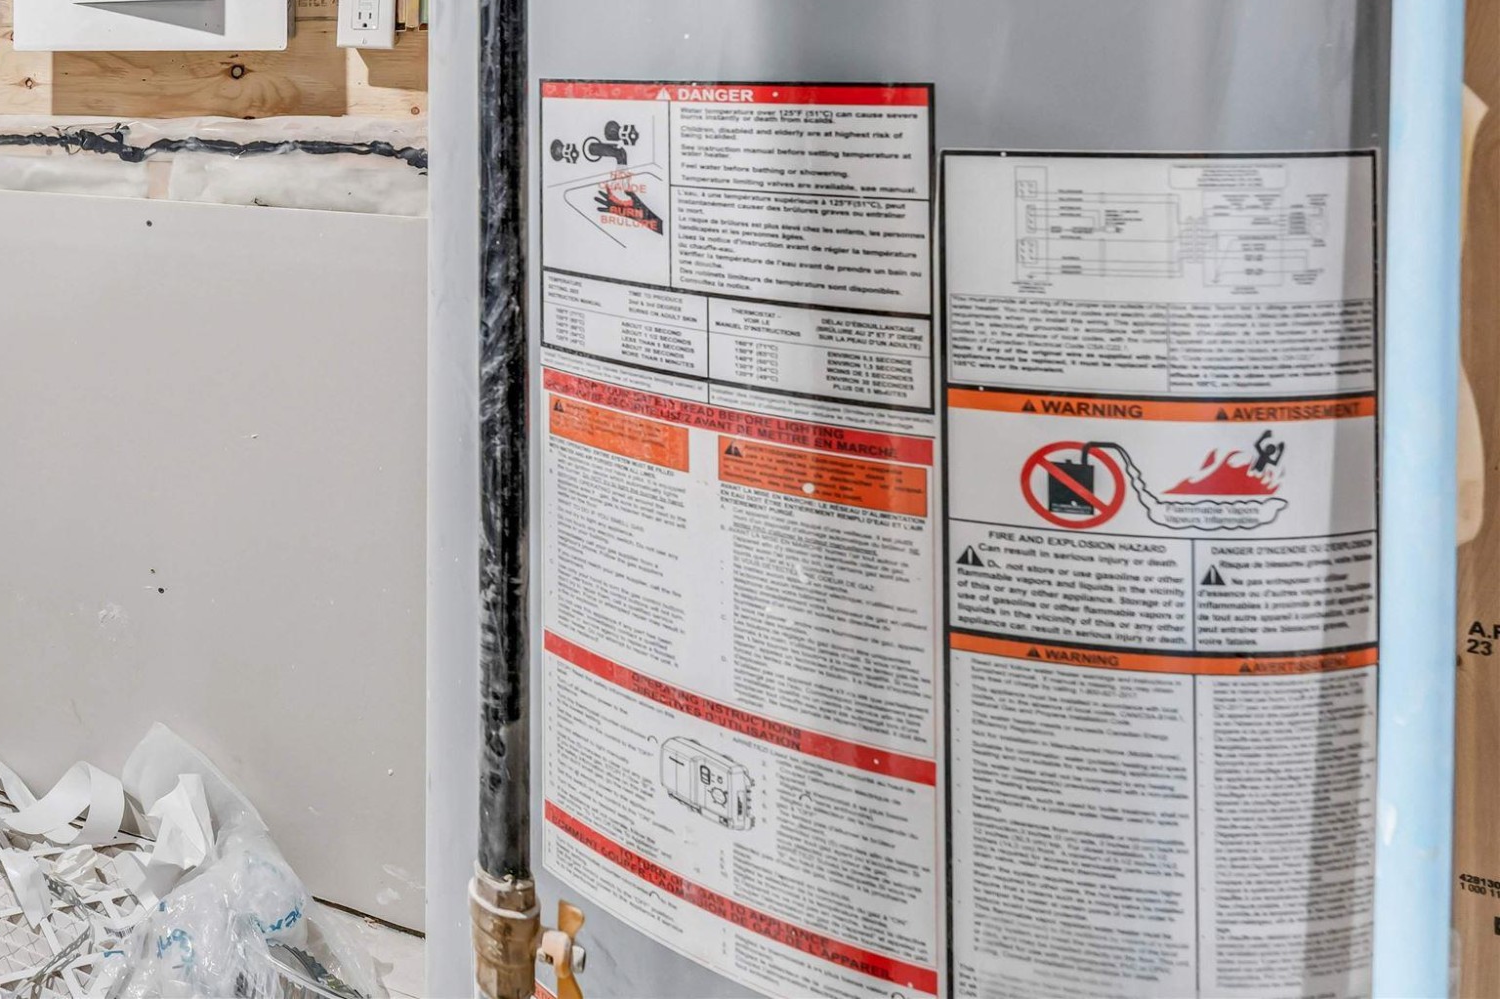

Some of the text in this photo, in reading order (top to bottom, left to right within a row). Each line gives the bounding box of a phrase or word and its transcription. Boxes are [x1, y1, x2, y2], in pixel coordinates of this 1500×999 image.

[678, 89, 754, 102] DANGER
[808, 150, 839, 158] setting
[682, 175, 730, 183] Temperature
[733, 178, 764, 187] limiting
[752, 167, 784, 175] bathing
[609, 206, 643, 218] BURN
[1041, 400, 1144, 418] WARNING
[680, 402, 715, 418] READ
[718, 410, 773, 428] BEFORE
[777, 420, 845, 441] LIGHTING
[660, 410, 692, 423] LISEZ
[694, 416, 732, 433] AVANT
[736, 425, 751, 434] DE
[758, 428, 810, 444] METTRE
[814, 438, 832, 449] EN
[837, 442, 895, 458] MARCHE
[988, 530, 1166, 554] FIRE AND EXPLOSION HAZARD
[979, 543, 1000, 552] Can
[1004, 546, 1037, 558] result
[1053, 552, 1095, 563] serious
[1098, 554, 1129, 567] injury
[957, 567, 1012, 582] flammable
[1016, 576, 1052, 587] vapors
[1056, 579, 1076, 589] and
[1079, 581, 1114, 593] liquids
[1130, 586, 1145, 594] the
[1006, 561, 1024, 571] not
[1027, 565, 1054, 575] store
[1072, 570, 1092, 578] use
[1096, 571, 1140, 583] gasoline
[1157, 574, 1184, 584] other
[1045, 649, 1120, 667] WARNING
[1466, 638, 1493, 656] 23
[632, 672, 801, 738] OPERATING INSTRUCTIONS
[632, 683, 801, 751] DIRECTIVES D'UTILISATION
[602, 847, 645, 879] COUPER
[731, 912, 748, 926] DE
[785, 934, 801, 949] DE
[636, 855, 667, 879] TURN
[730, 902, 746, 915] TO
[750, 910, 829, 945] APPLIANCE
[1468, 884, 1487, 895] 000
